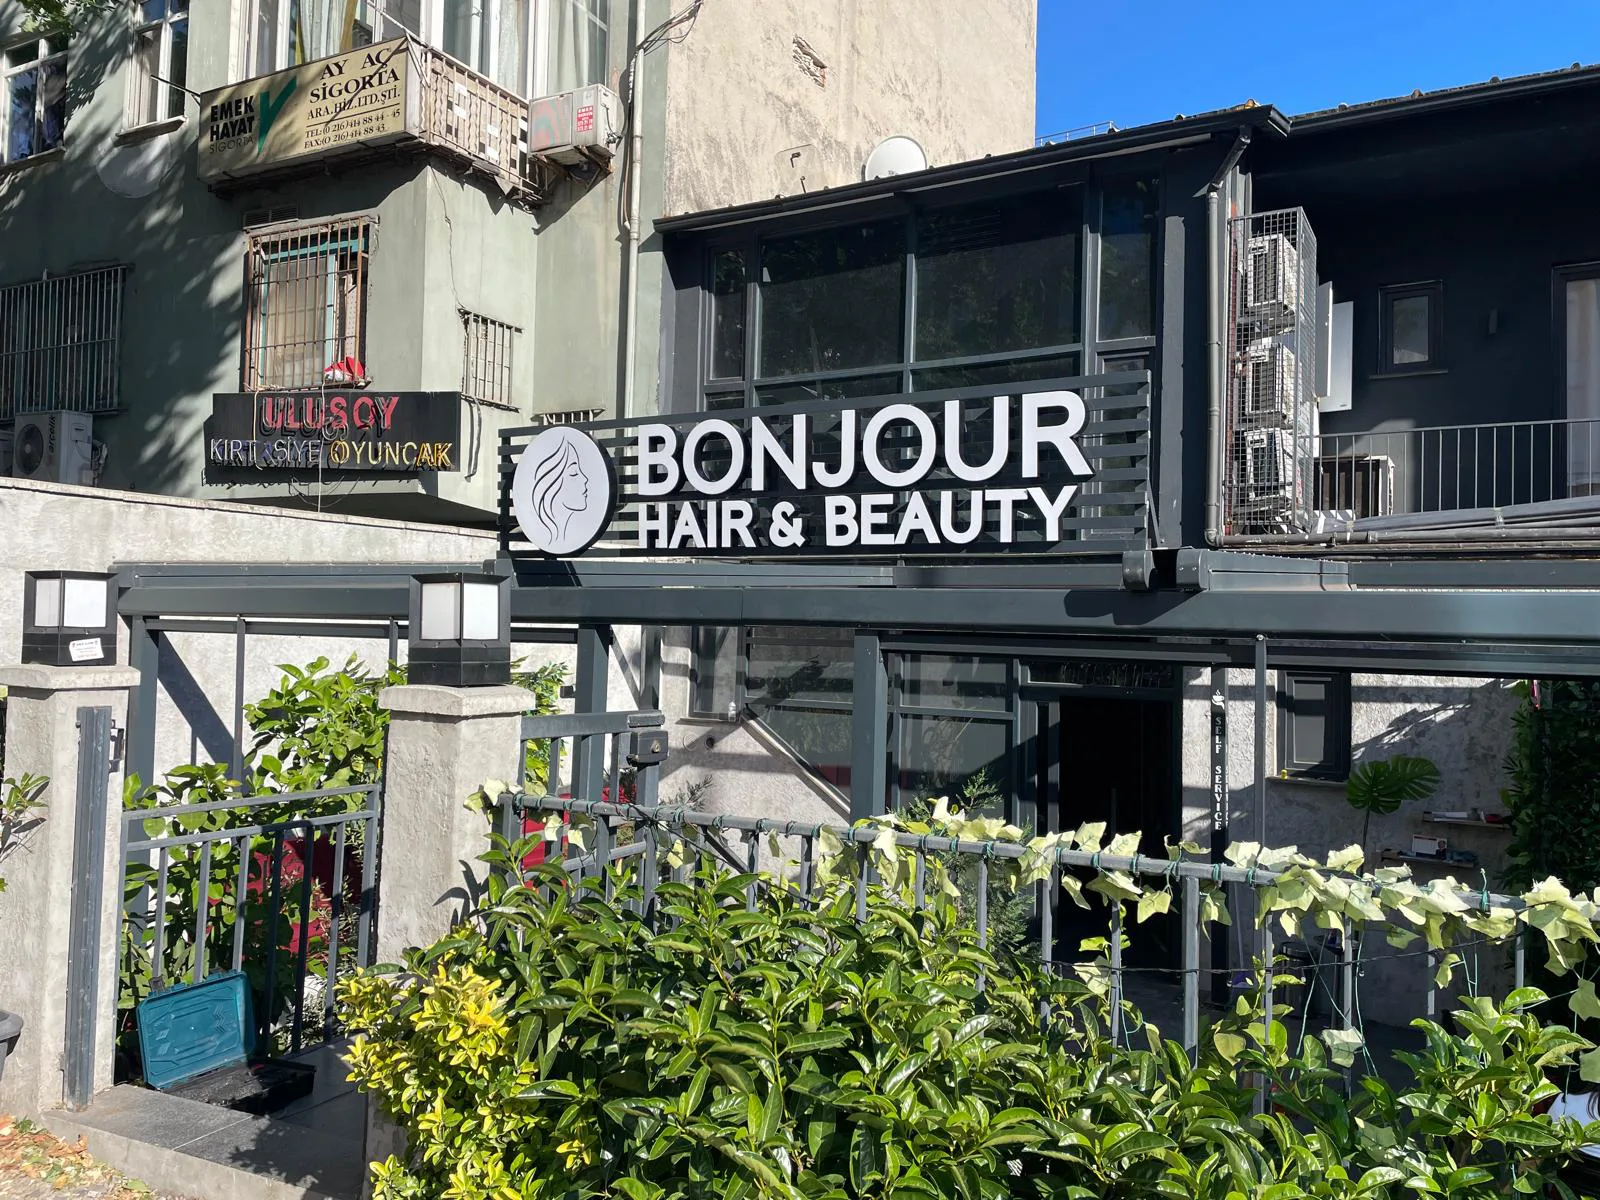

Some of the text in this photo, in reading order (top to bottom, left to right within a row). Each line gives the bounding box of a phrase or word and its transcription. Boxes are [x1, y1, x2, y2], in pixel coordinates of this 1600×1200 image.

[320, 47, 391, 80] AY AÇ
[310, 67, 400, 103] SİGORTA
[210, 95, 254, 123] EMEK
[209, 116, 254, 142] HAYAT
[263, 395, 399, 430] ULUSOY
[330, 440, 452, 467] OYUNCAK
[637, 389, 1094, 496] BONJOUR
[638, 485, 1079, 549] HAIR & BEAUTY
[1214, 717, 1223, 831] SELF SERVICE
